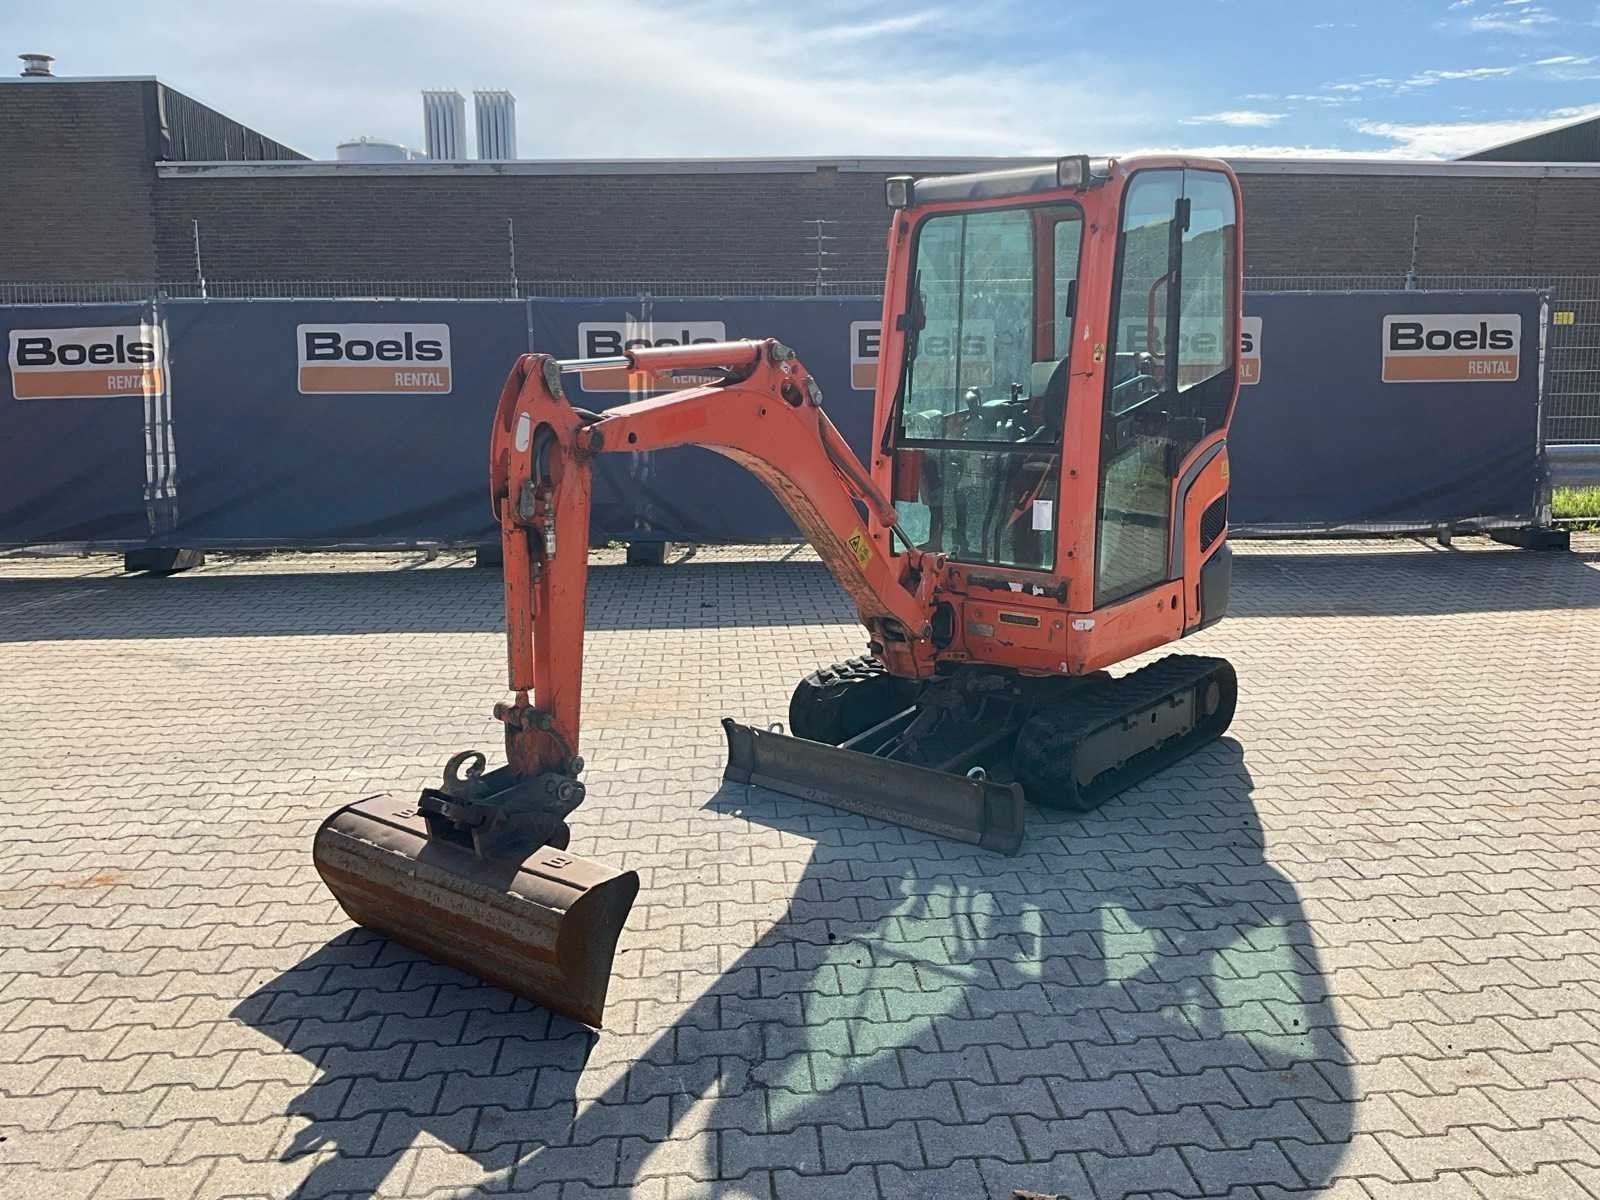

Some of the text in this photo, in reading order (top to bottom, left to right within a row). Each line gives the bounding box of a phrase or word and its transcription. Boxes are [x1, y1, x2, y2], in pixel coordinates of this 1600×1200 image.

[17, 335, 155, 366] Boels
[305, 332, 443, 361] Boels
[1390, 322, 1514, 351] Boels
[394, 372, 444, 387] RENTAL
[1468, 360, 1513, 375] RENTAL
